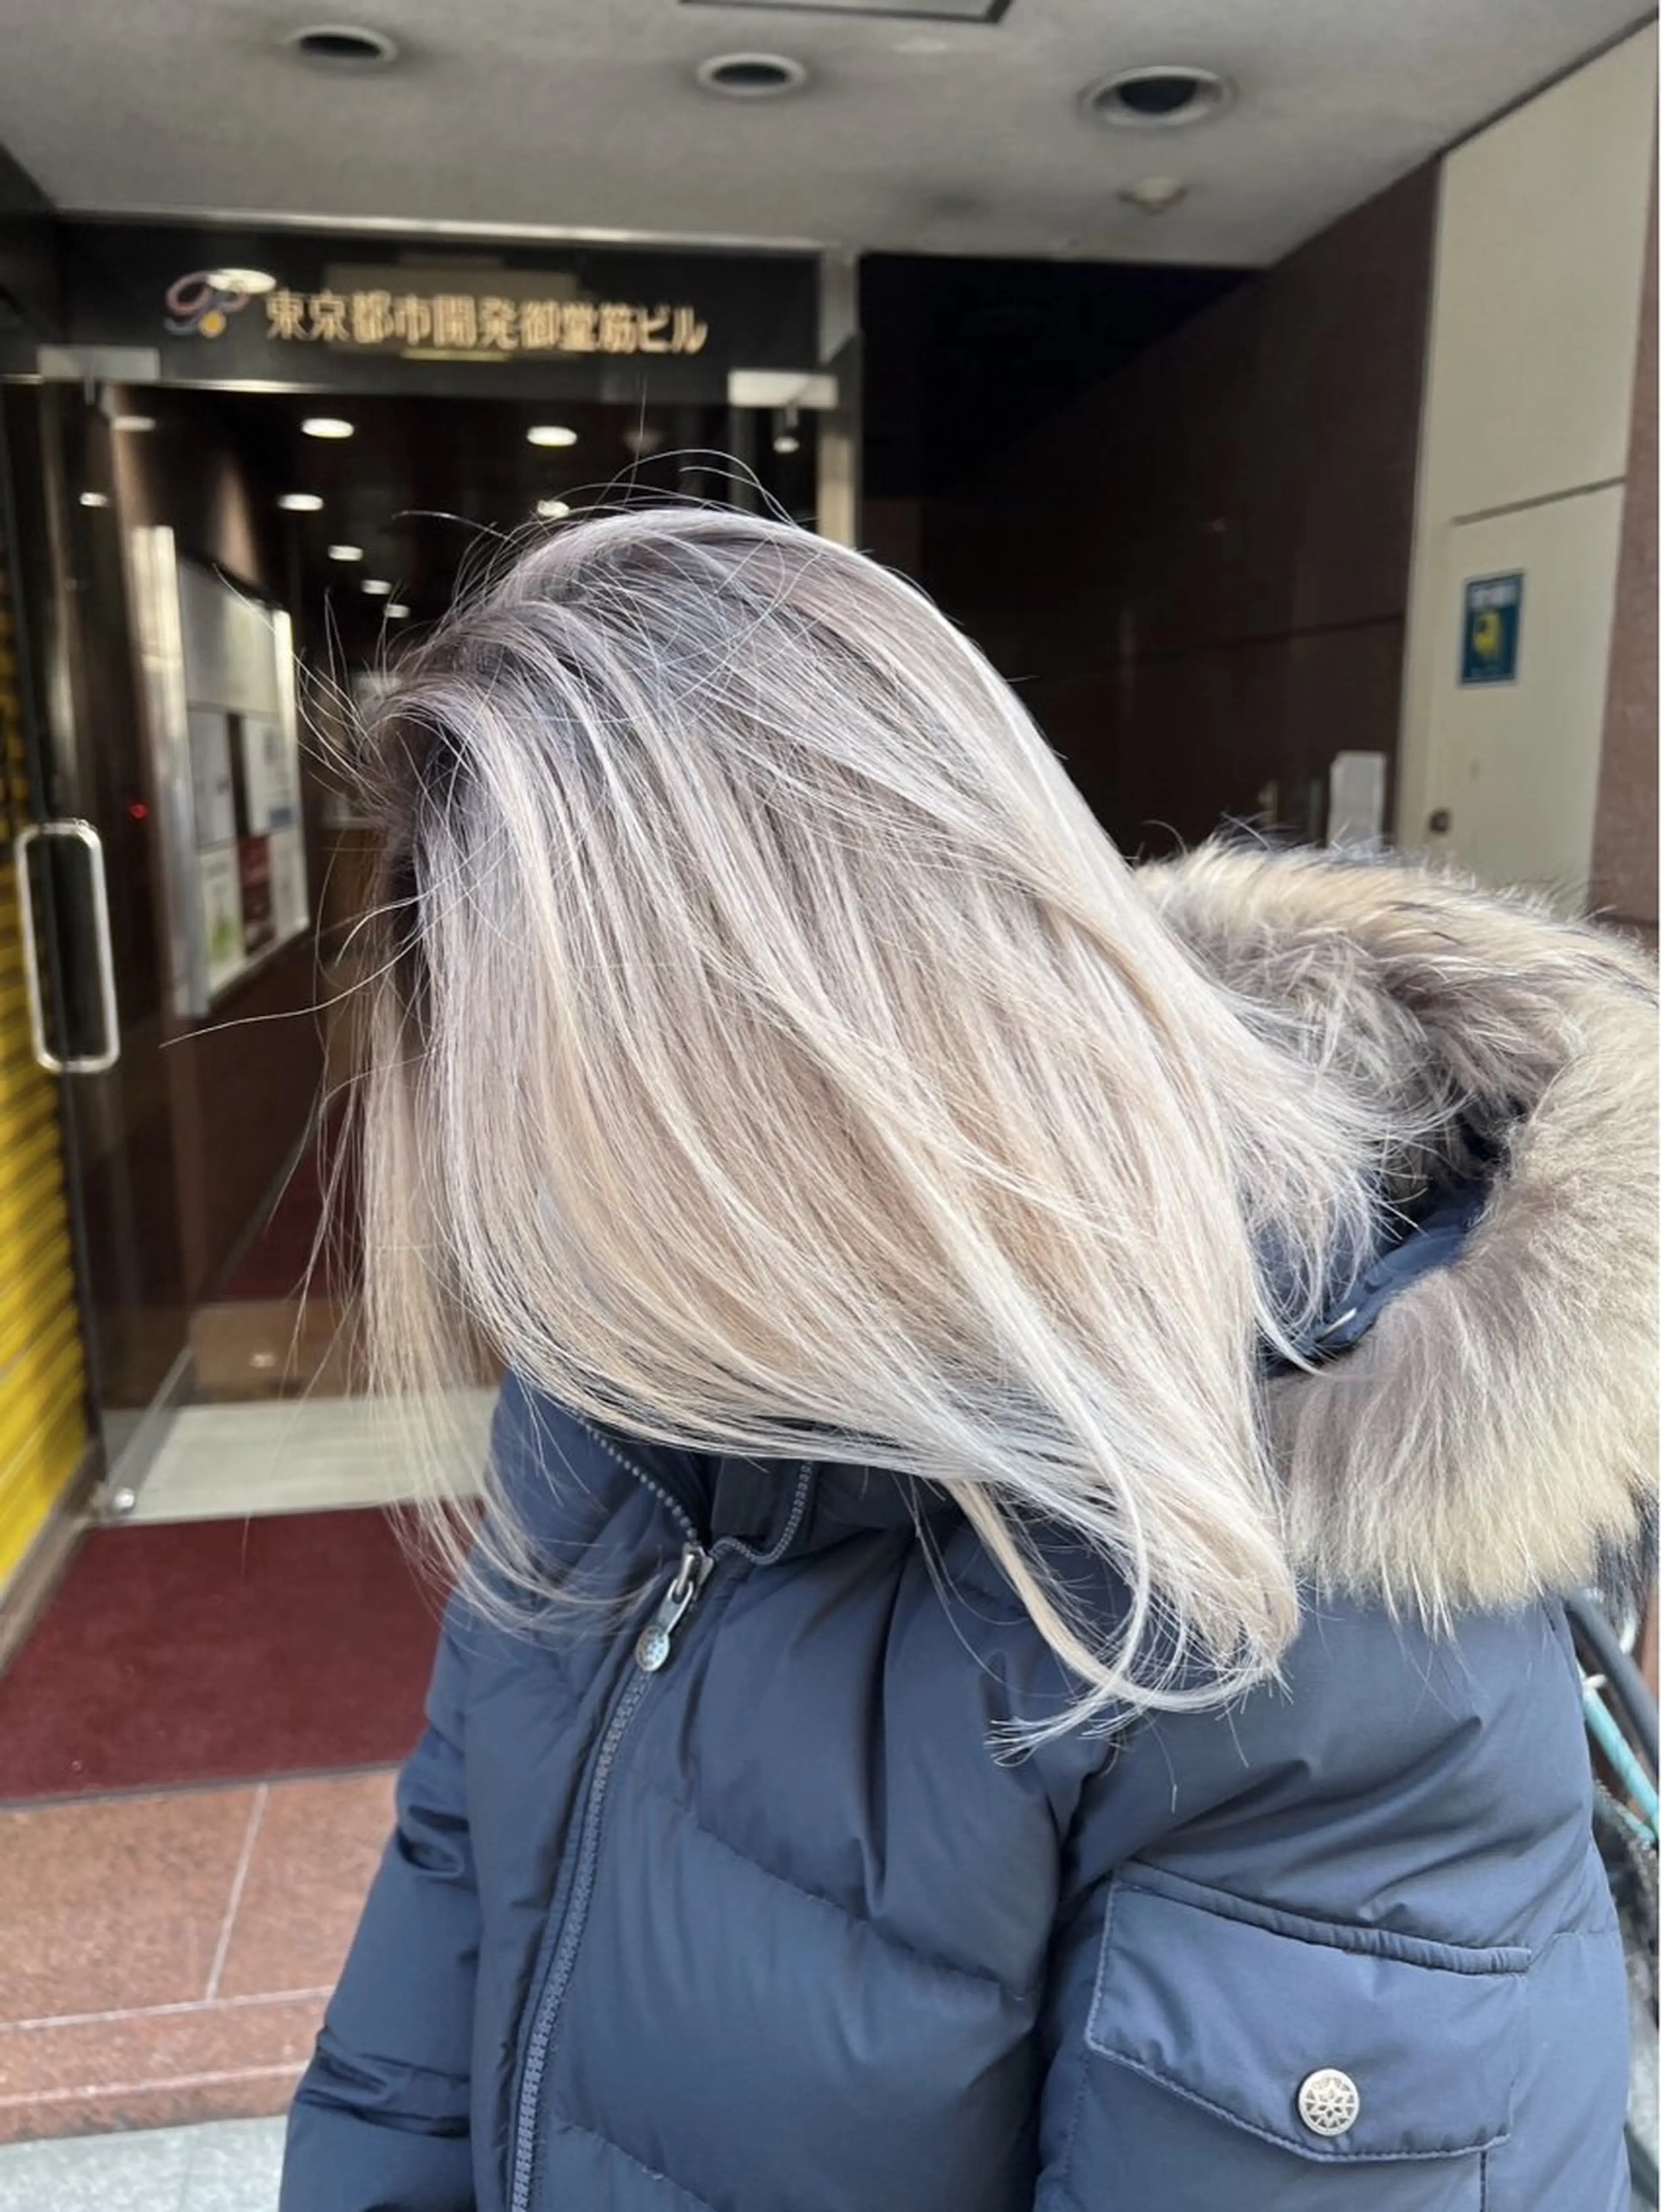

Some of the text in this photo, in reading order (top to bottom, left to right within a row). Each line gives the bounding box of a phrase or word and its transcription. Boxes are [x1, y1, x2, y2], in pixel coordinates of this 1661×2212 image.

[266, 289, 708, 354] 東京都市開発御堂筋ビル
